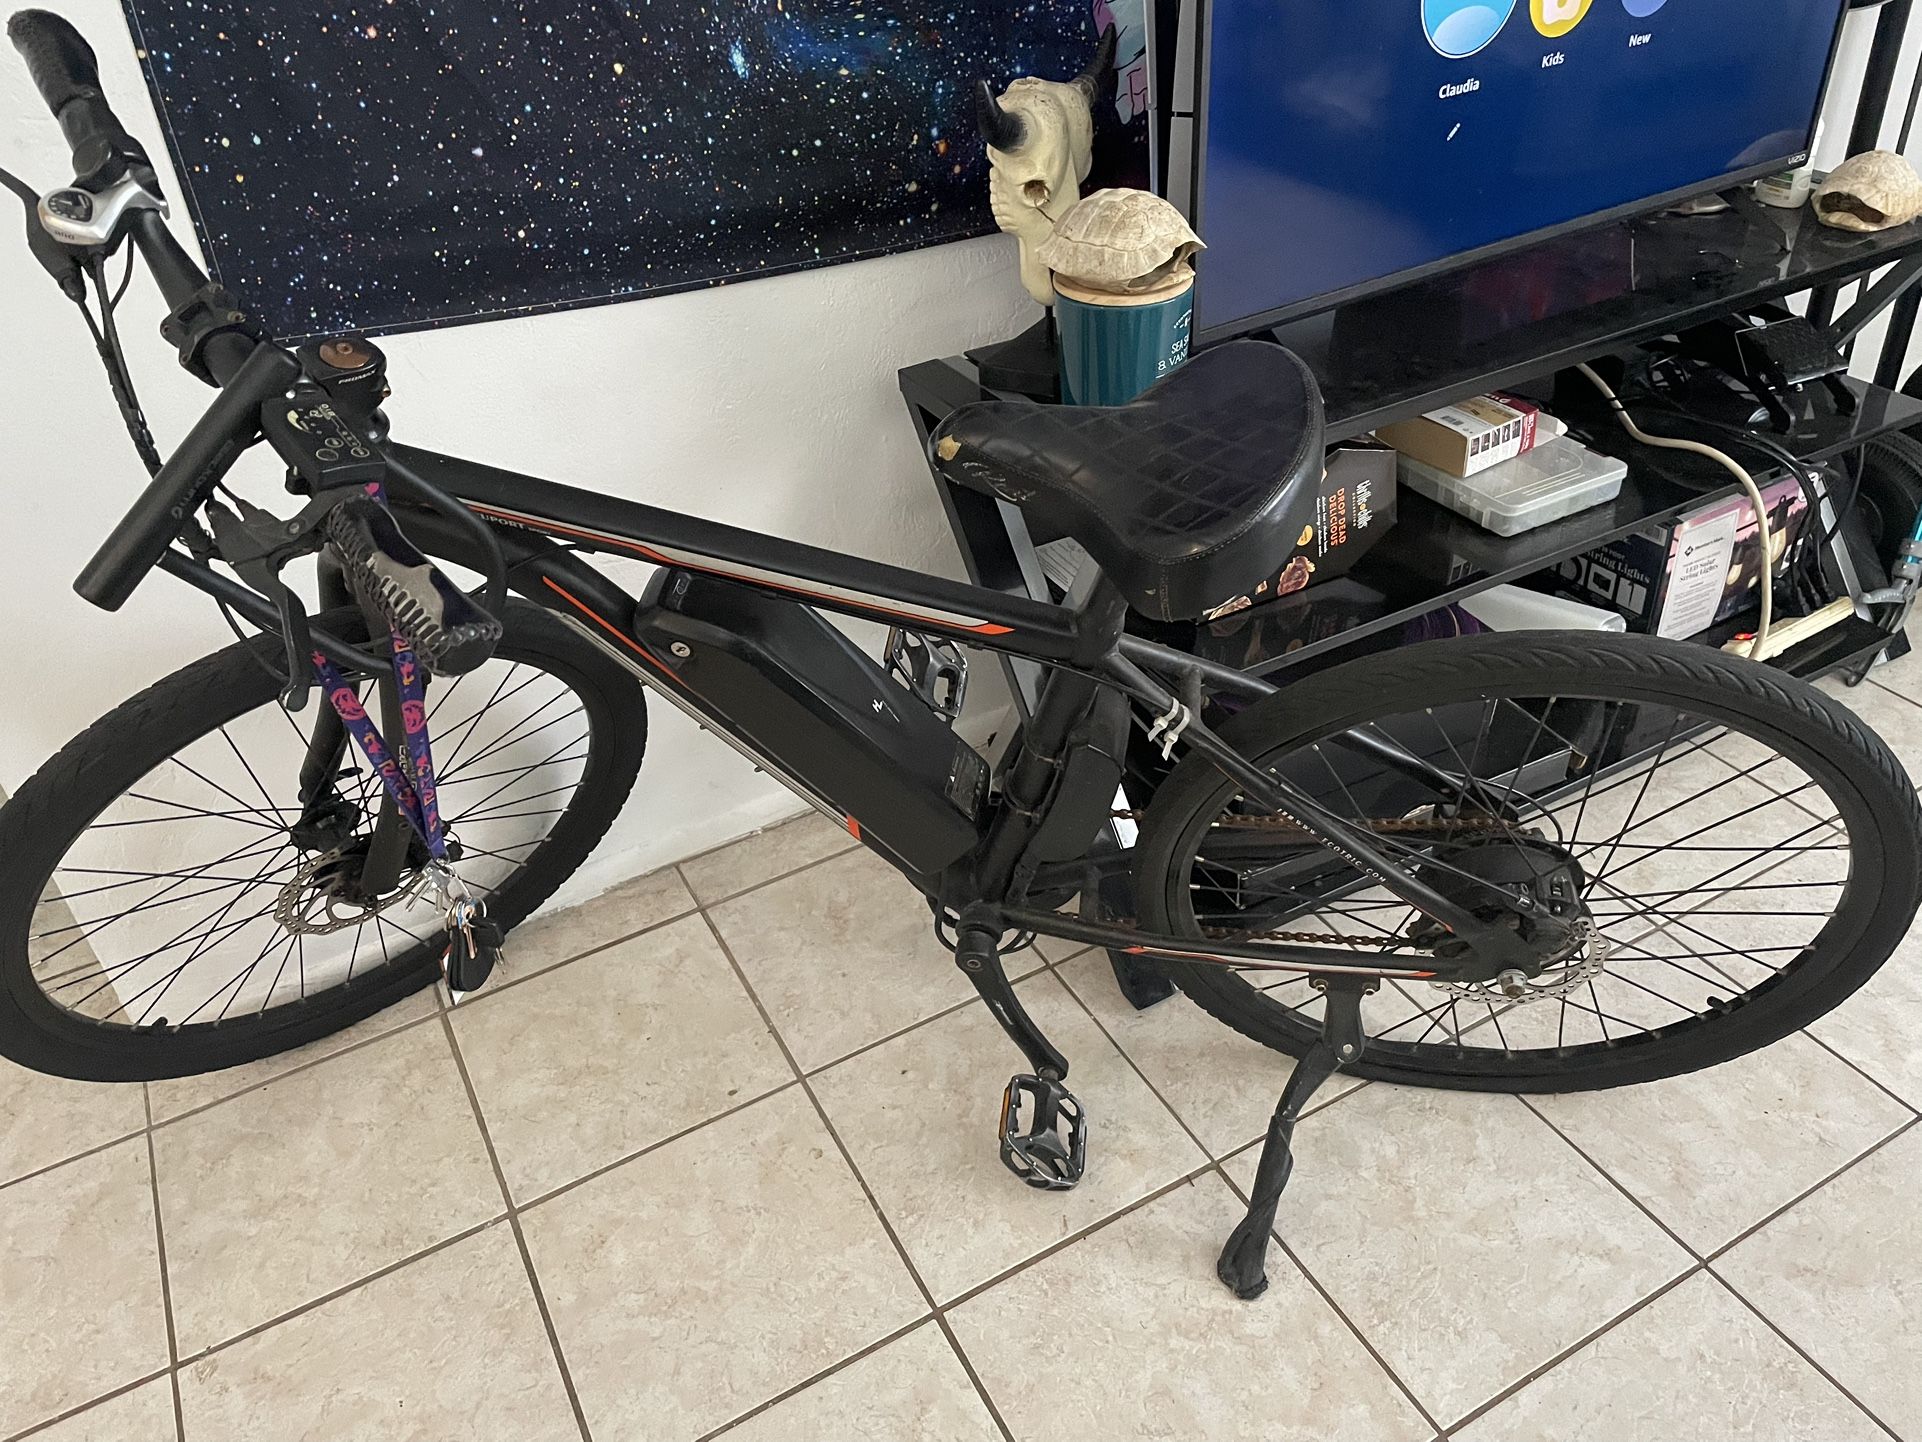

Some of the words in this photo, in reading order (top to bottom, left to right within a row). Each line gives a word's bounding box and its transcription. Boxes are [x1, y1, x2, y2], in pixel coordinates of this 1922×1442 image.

[1628, 32, 1652, 48] New
[1541, 51, 1565, 68] Kids
[1438, 77, 1480, 99] Claudia
[1337, 487, 1346, 516] DROP
[1329, 494, 1339, 546] DELICIOUS
[1338, 517, 1347, 544] DEAD
[1617, 562, 1650, 583] Lights
